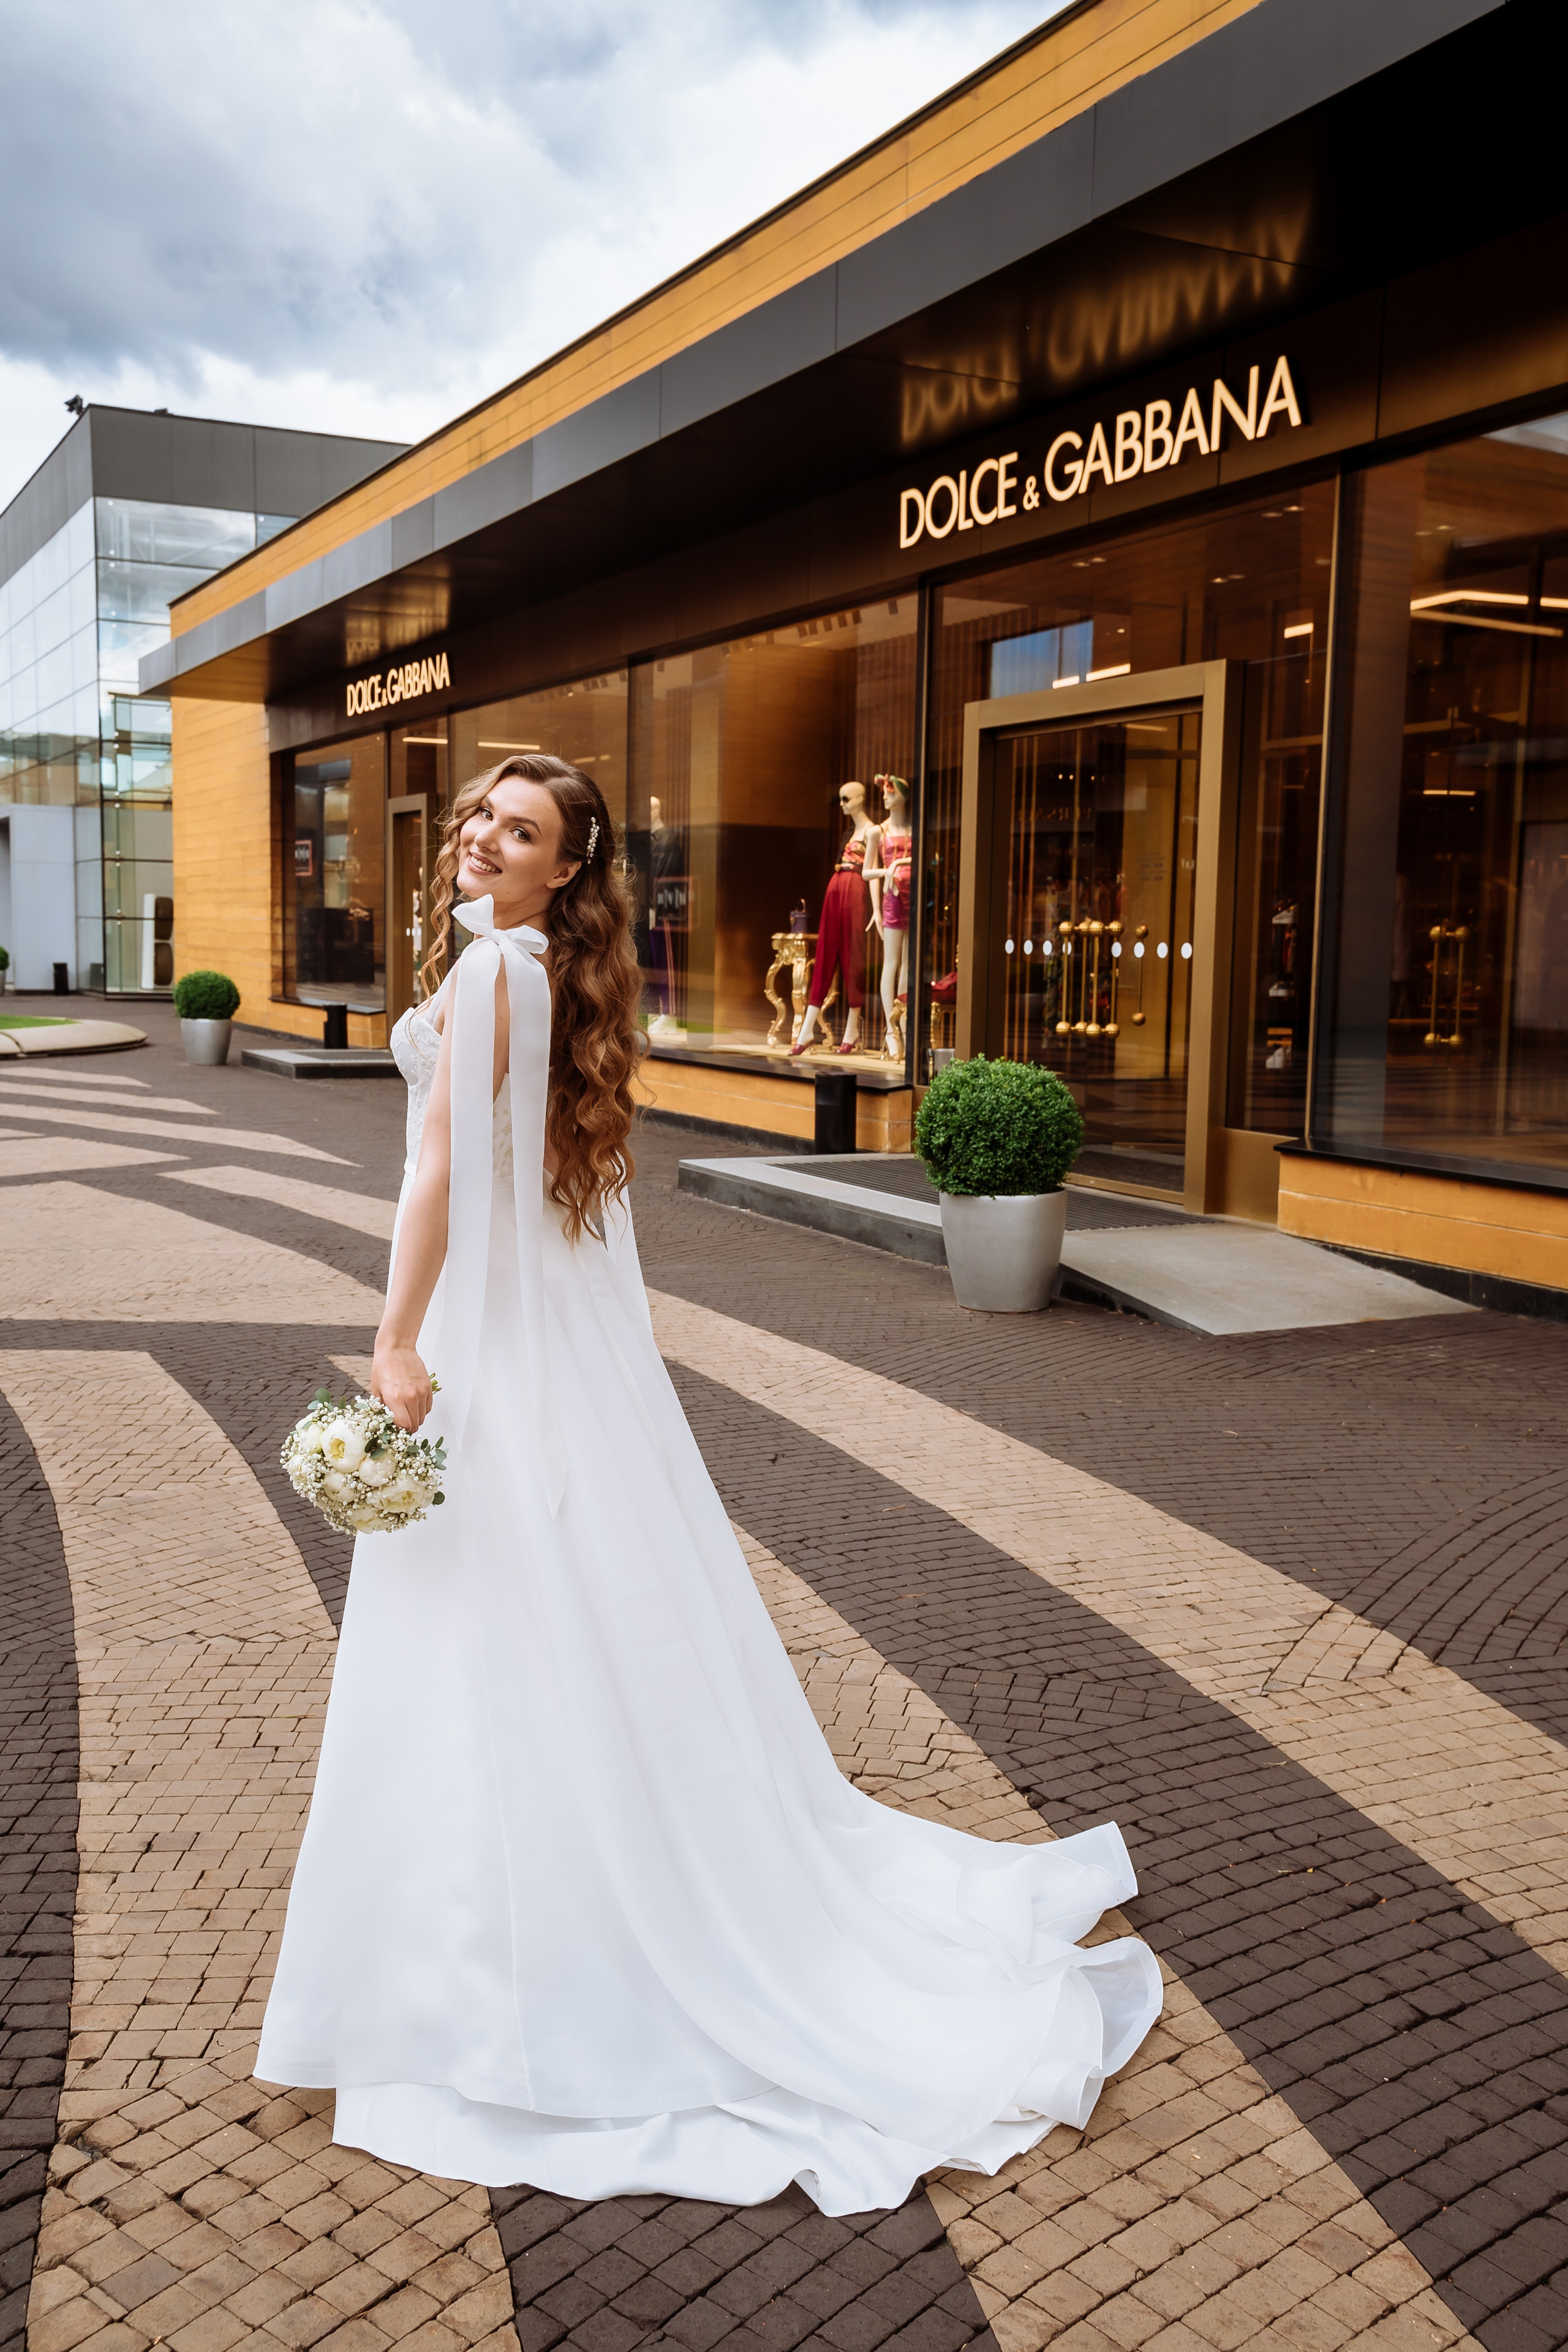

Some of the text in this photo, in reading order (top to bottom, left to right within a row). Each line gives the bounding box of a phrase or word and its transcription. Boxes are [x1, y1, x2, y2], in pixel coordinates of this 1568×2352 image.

[900, 451, 1018, 549] DOLCE
[1023, 477, 1040, 511] &
[1044, 356, 1302, 502] GABBANA
[347, 674, 381, 717] DOLCE
[387, 652, 450, 704] GABBANA
